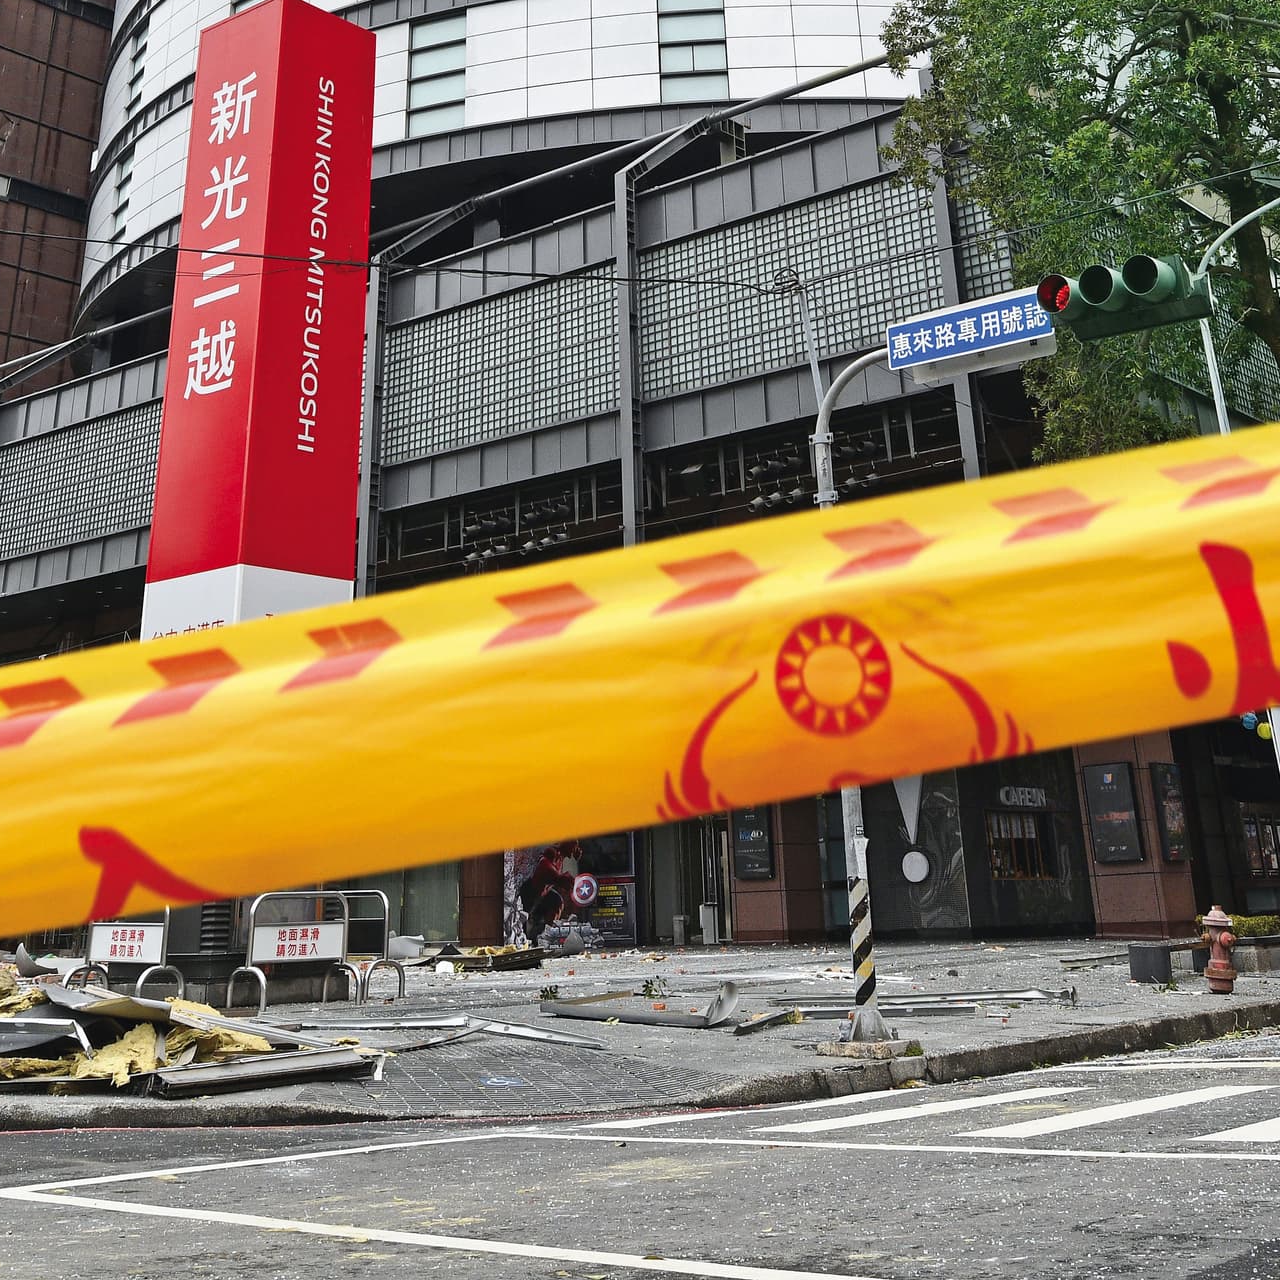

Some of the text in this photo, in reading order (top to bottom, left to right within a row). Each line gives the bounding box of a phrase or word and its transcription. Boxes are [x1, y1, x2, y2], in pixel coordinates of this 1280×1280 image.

[183, 70, 257, 400] 新光三越
[891, 303, 1048, 360] 惠來路專用號誌
[296, 246, 326, 453] MITSUKOSHI
